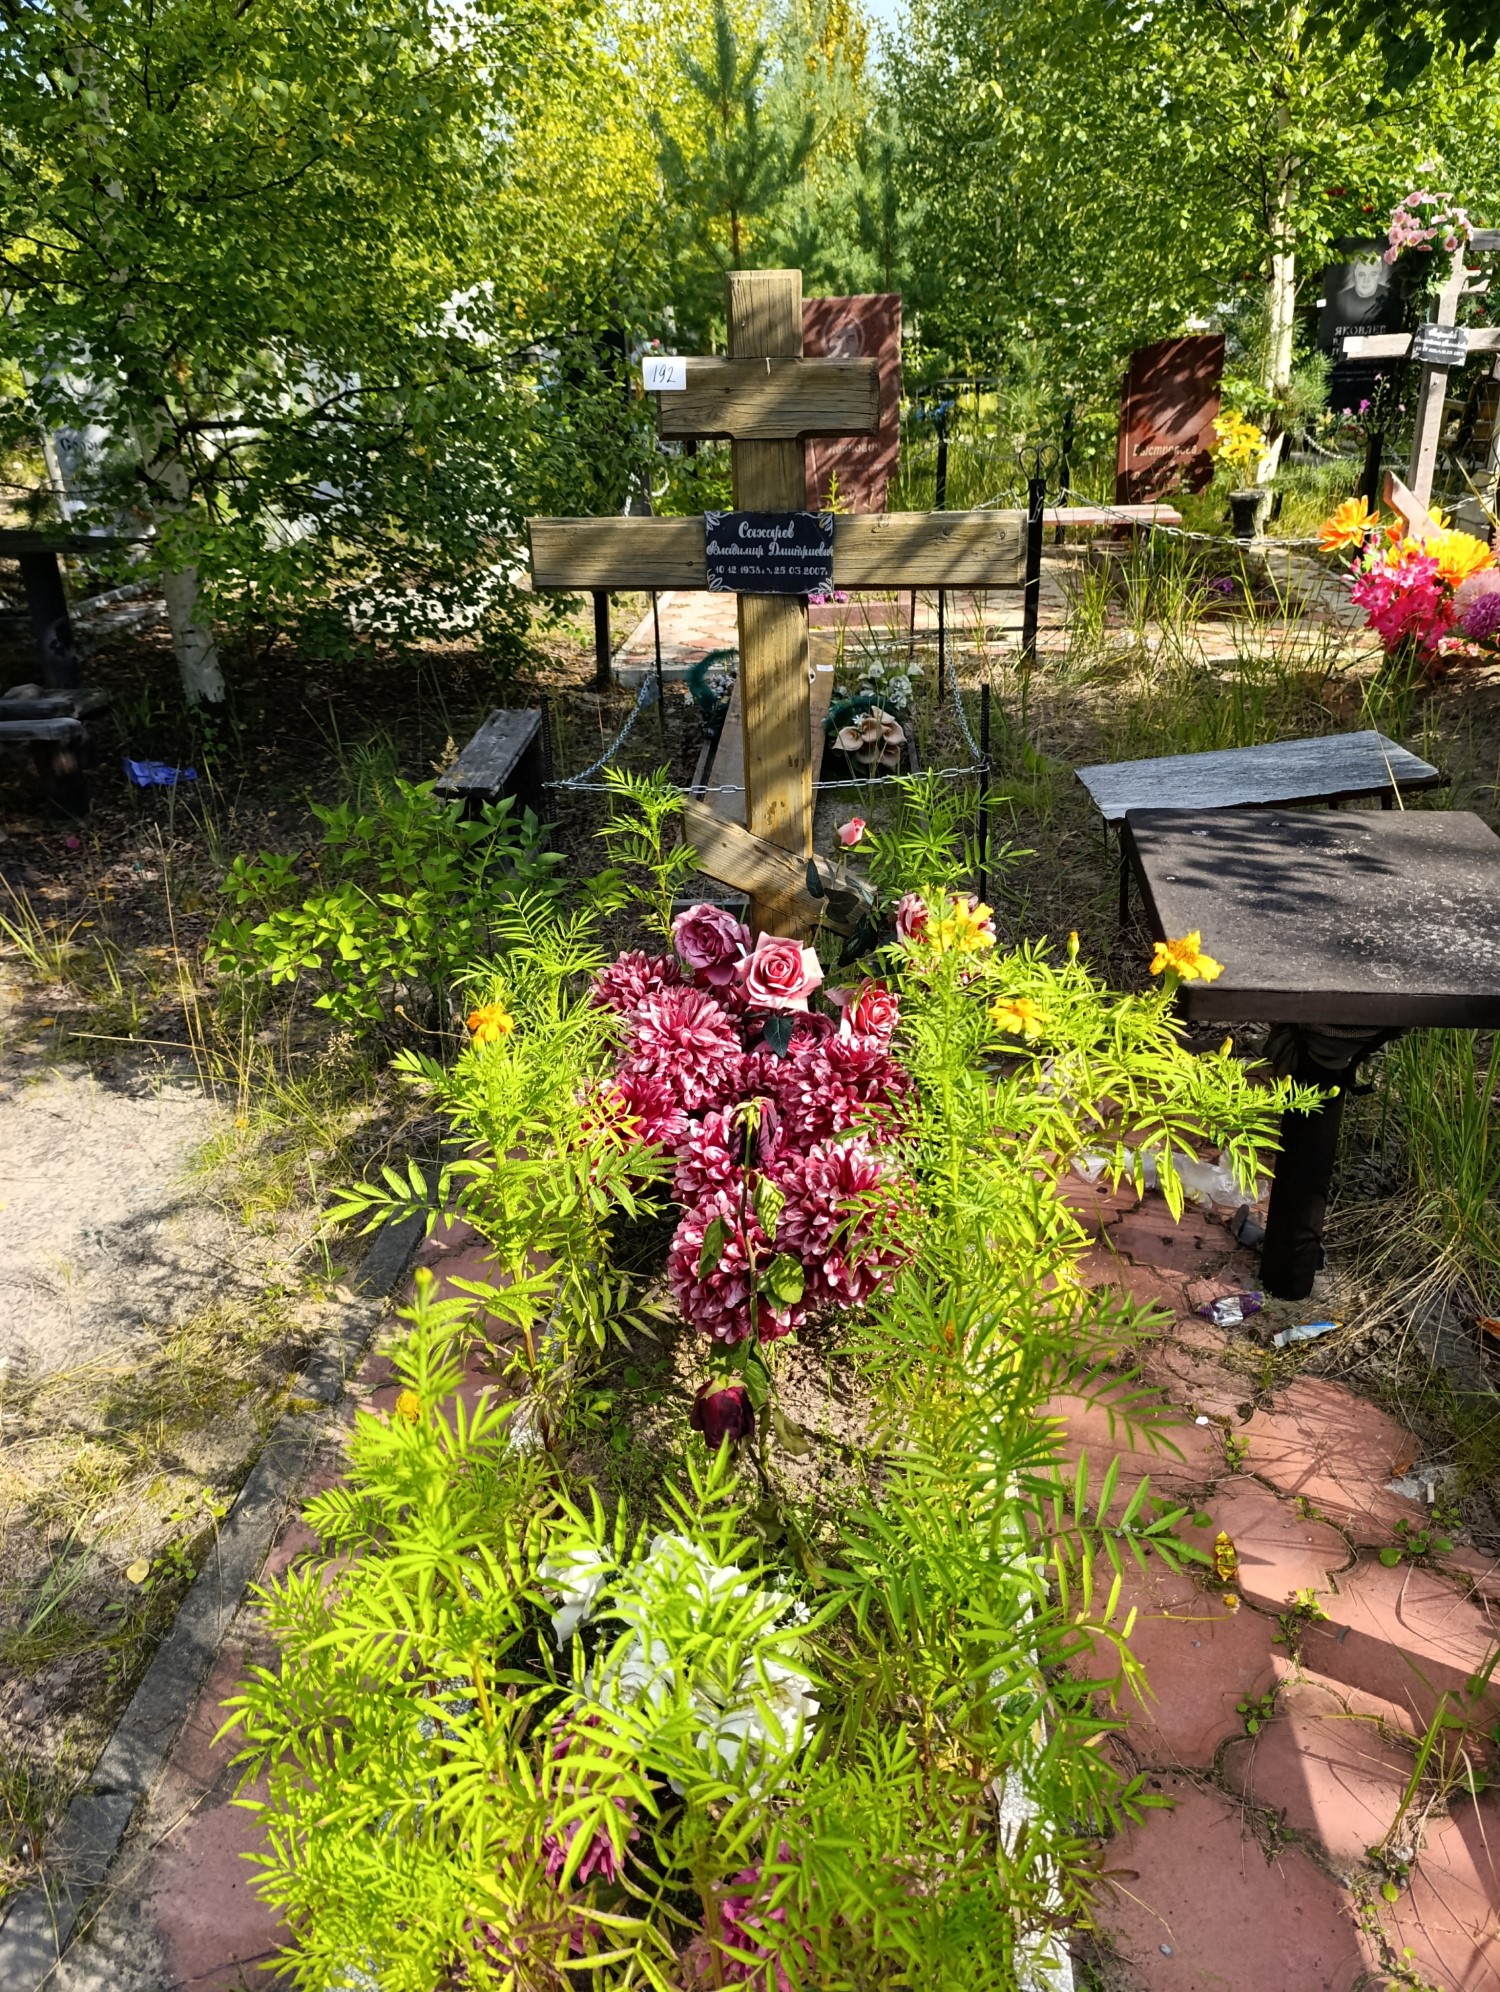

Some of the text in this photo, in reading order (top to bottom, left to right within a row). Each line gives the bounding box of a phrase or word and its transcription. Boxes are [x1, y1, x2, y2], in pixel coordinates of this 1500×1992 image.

[652, 363, 676, 384] 192
[738, 520, 795, 542] Сахаров
[706, 539, 764, 559] Владимир
[715, 565, 725, 574] 10
[727, 565, 737, 574] 12
[773, 566, 786, 575] 25
[788, 566, 801, 575] 03
